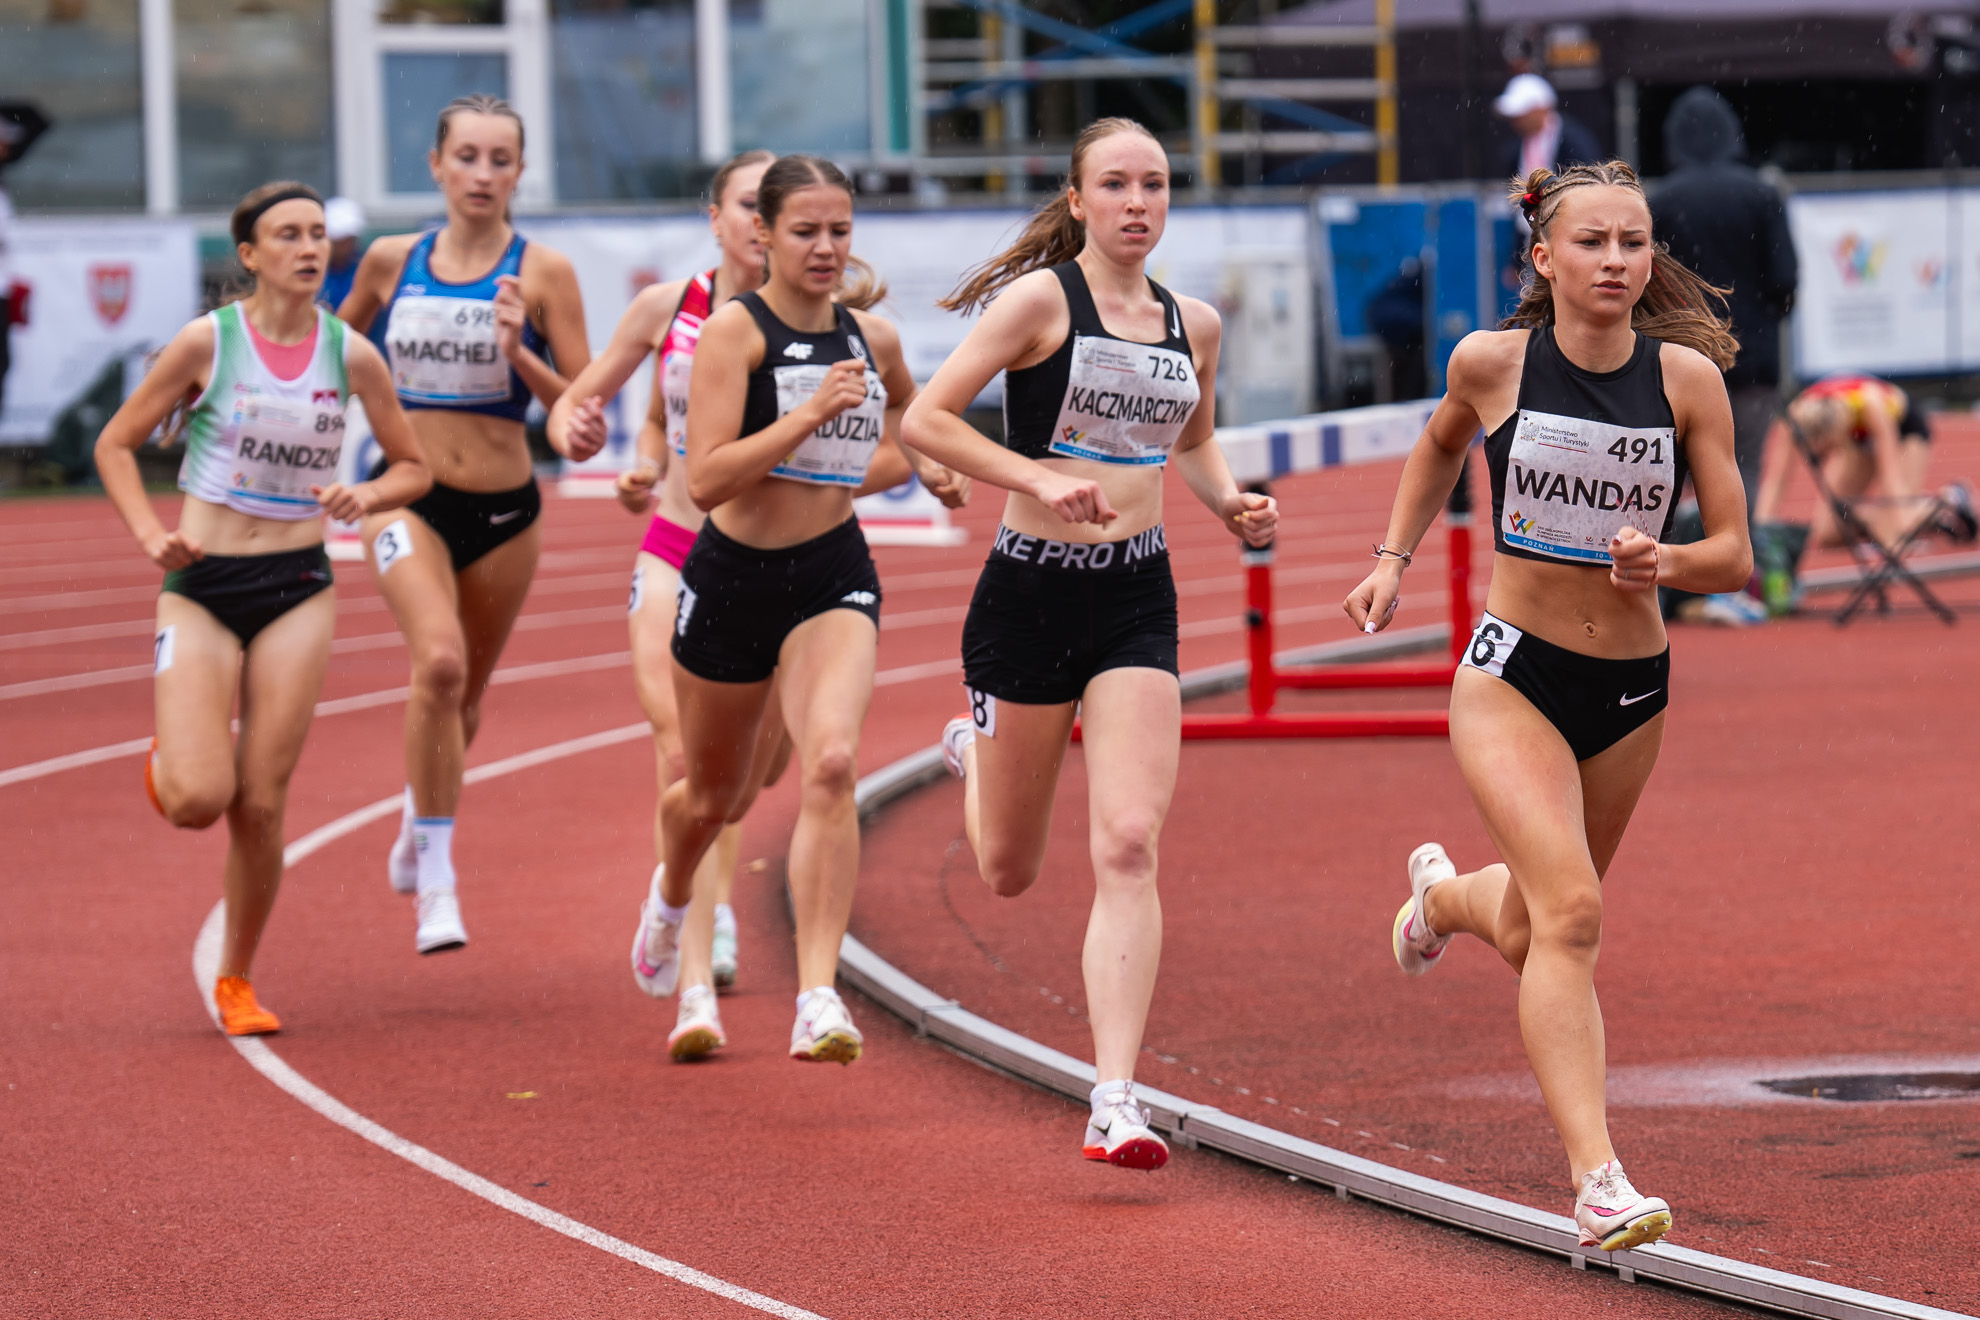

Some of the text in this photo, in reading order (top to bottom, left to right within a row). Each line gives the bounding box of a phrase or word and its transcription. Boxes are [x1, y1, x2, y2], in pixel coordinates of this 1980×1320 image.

[396, 339, 498, 365] MACHEJ
[783, 341, 815, 360] 4F
[1148, 355, 1187, 382] 726
[1067, 386, 1194, 425] KACZMARCZYK
[1539, 432, 1559, 442] Sportu
[1563, 436, 1590, 448] Turystyki
[1540, 425, 1579, 438] Ministerstwo
[1607, 436, 1664, 465] 491
[1514, 464, 1666, 513] WANDAS
[379, 532, 398, 561] 3
[993, 522, 1168, 570] IKE PRO NIK
[1522, 539, 1555, 552] POZNAŃ
[1471, 622, 1504, 667] 6
[971, 686, 988, 729] 8
